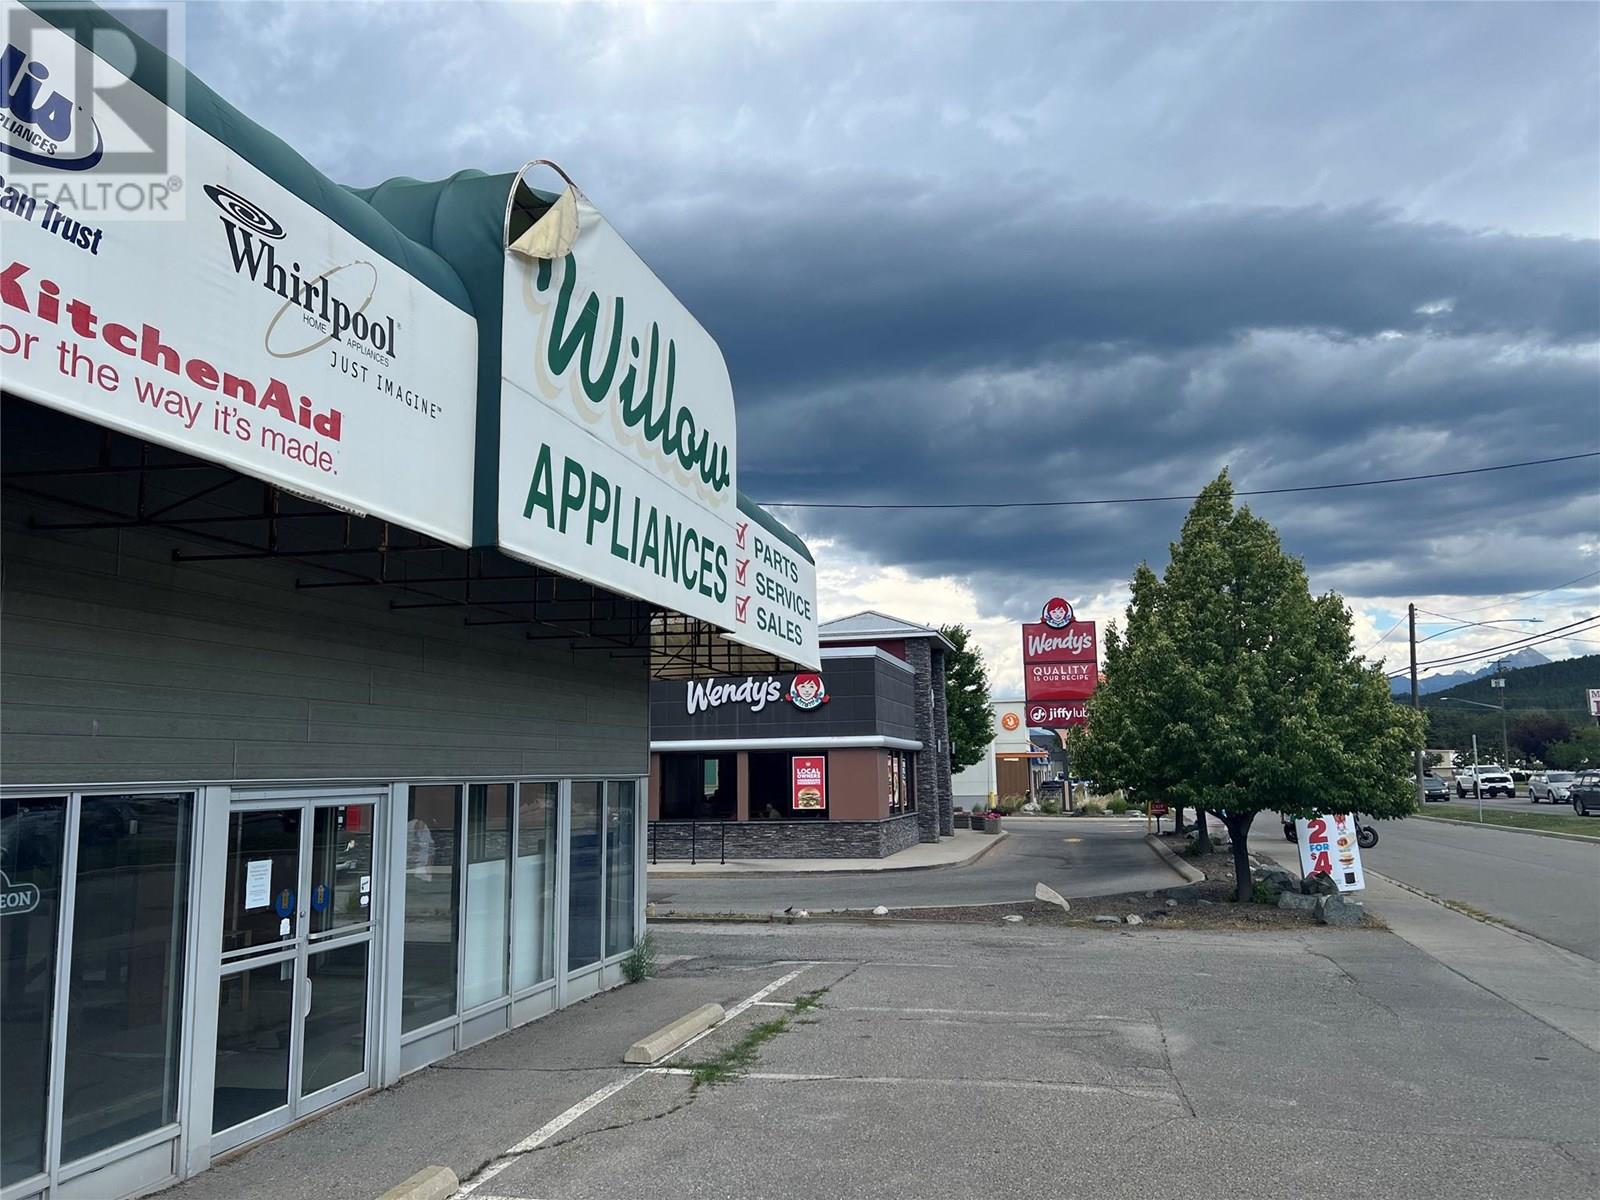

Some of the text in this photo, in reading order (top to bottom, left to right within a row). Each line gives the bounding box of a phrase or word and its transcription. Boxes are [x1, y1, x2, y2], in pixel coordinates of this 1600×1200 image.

[41, 200, 103, 255] Trust
[220, 216, 396, 358] Whirlpool
[303, 313, 389, 367] HOME APPLIANCES
[331, 351, 368, 383] JUST
[536, 252, 730, 492] Willow
[57, 340, 119, 392] the
[135, 376, 203, 429] way
[214, 400, 251, 441] it's
[261, 426, 338, 475] made.
[523, 443, 728, 603] APPLIANCES
[754, 536, 798, 583] PARTS
[756, 572, 811, 620] SERVICE
[757, 607, 803, 646] SALES
[1028, 629, 1092, 656] Wendy's
[1033, 665, 1088, 676] QUALITY
[1043, 674, 1059, 682] OUR
[1061, 674, 1089, 682] RECIPE
[687, 676, 781, 714] Wendy's
[1049, 707, 1072, 721] jiffy
[1307, 819, 1328, 843] 2
[1310, 843, 1330, 852] FOR
